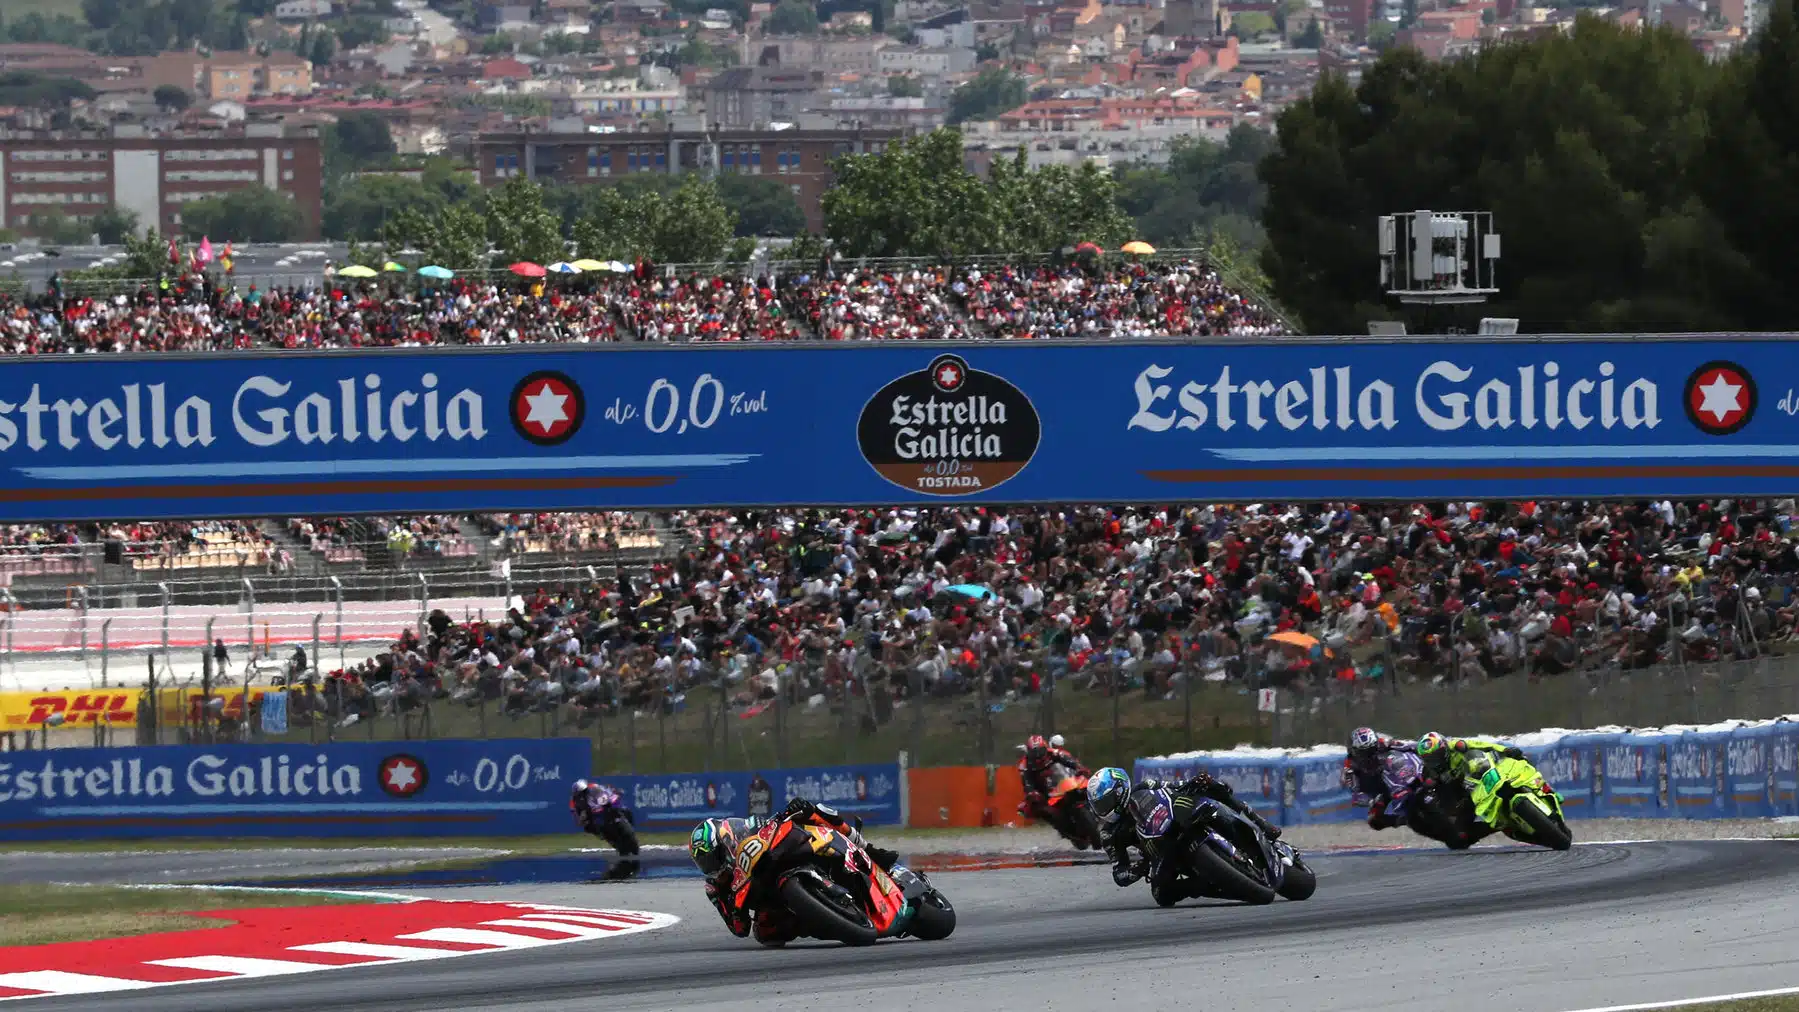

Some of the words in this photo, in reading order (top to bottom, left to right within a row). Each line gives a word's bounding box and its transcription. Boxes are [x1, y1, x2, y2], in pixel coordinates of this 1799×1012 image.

[233, 374, 488, 446] Galicia
[605, 397, 639, 425] alc.
[645, 373, 724, 434] 0,0
[730, 390, 768, 416] %vol
[889, 395, 1007, 425] Estrella
[1128, 364, 1399, 431] Estrella
[1416, 361, 1662, 431] Galicia
[1777, 388, 1799, 416] al
[895, 427, 1002, 459] Galicia
[917, 476, 982, 488] TOSTADA
[27, 694, 134, 724] DHL
[186, 754, 362, 797] Galicia
[473, 754, 531, 792] 0,0
[738, 839, 763, 873] 33
